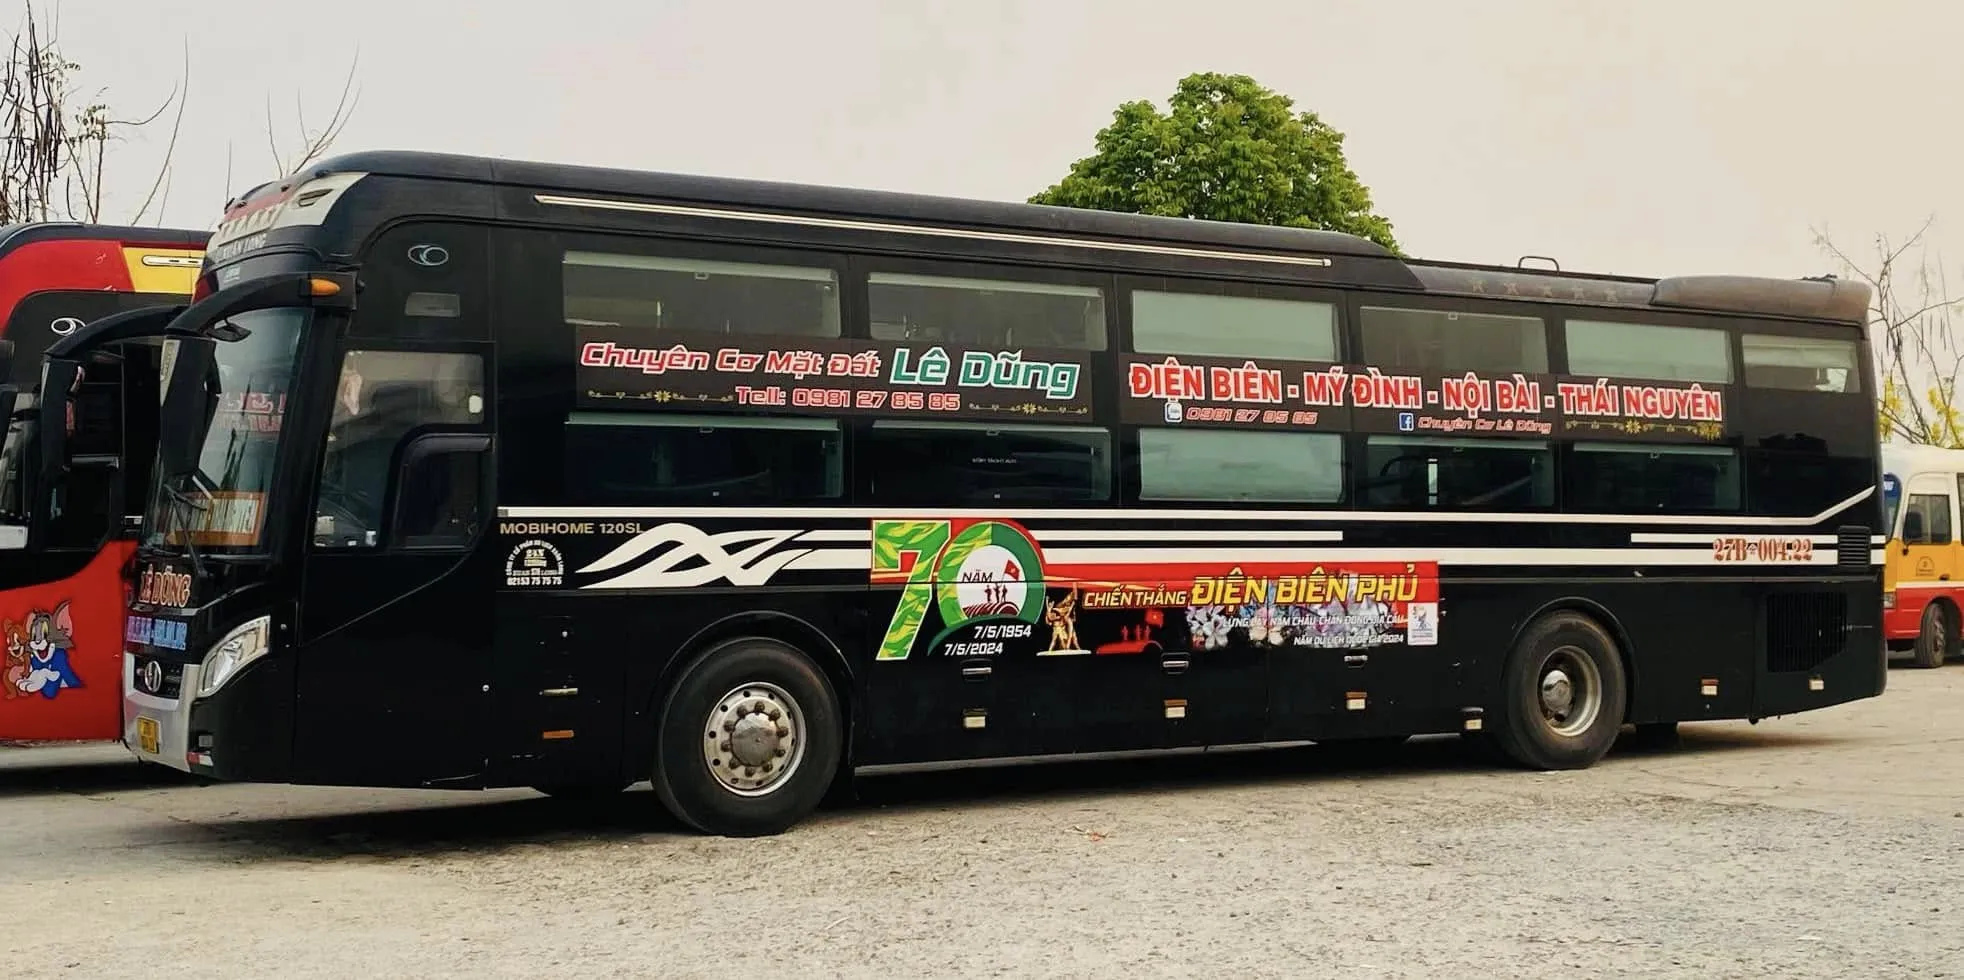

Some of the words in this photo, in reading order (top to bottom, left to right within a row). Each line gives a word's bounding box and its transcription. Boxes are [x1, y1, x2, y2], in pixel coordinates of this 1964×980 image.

[581, 343, 710, 374] Chuyên
[715, 348, 763, 372] Cơ
[765, 350, 824, 379] Mặt
[827, 351, 882, 377] Đất
[890, 346, 951, 385] Lê
[958, 349, 1081, 400] Dũng
[735, 386, 787, 405] Tell:
[792, 388, 851, 408] 0981
[856, 391, 887, 409] 27
[891, 391, 924, 410] 85
[928, 393, 961, 411] 85
[1129, 356, 1205, 402] ĐIỆN
[1211, 361, 1283, 403] BIÊN
[1303, 365, 1348, 406] MỸ
[1351, 366, 1423, 409] ĐÌNH
[1442, 372, 1491, 419] NỘI
[1495, 373, 1541, 413] BÀI
[1557, 378, 1620, 416] THÁI
[1623, 383, 1723, 421] NGUYÊN
[1186, 407, 1232, 421] 0981
[1235, 409, 1260, 422] 27
[500, 522, 594, 534] MOBIHOME
[599, 522, 644, 534] 120SL
[151, 565, 191, 608] DŨNG
[961, 569, 994, 583] NĂM
[1084, 585, 1133, 606] CHIẾN
[1135, 584, 1187, 606] THẮNG
[1191, 566, 1268, 613] ĐIỆN
[1275, 566, 1351, 604] BIÊN
[1355, 564, 1418, 602] PHỦ
[974, 624, 1032, 639] 7/5/1954
[944, 642, 1003, 656] 7/5/2024
